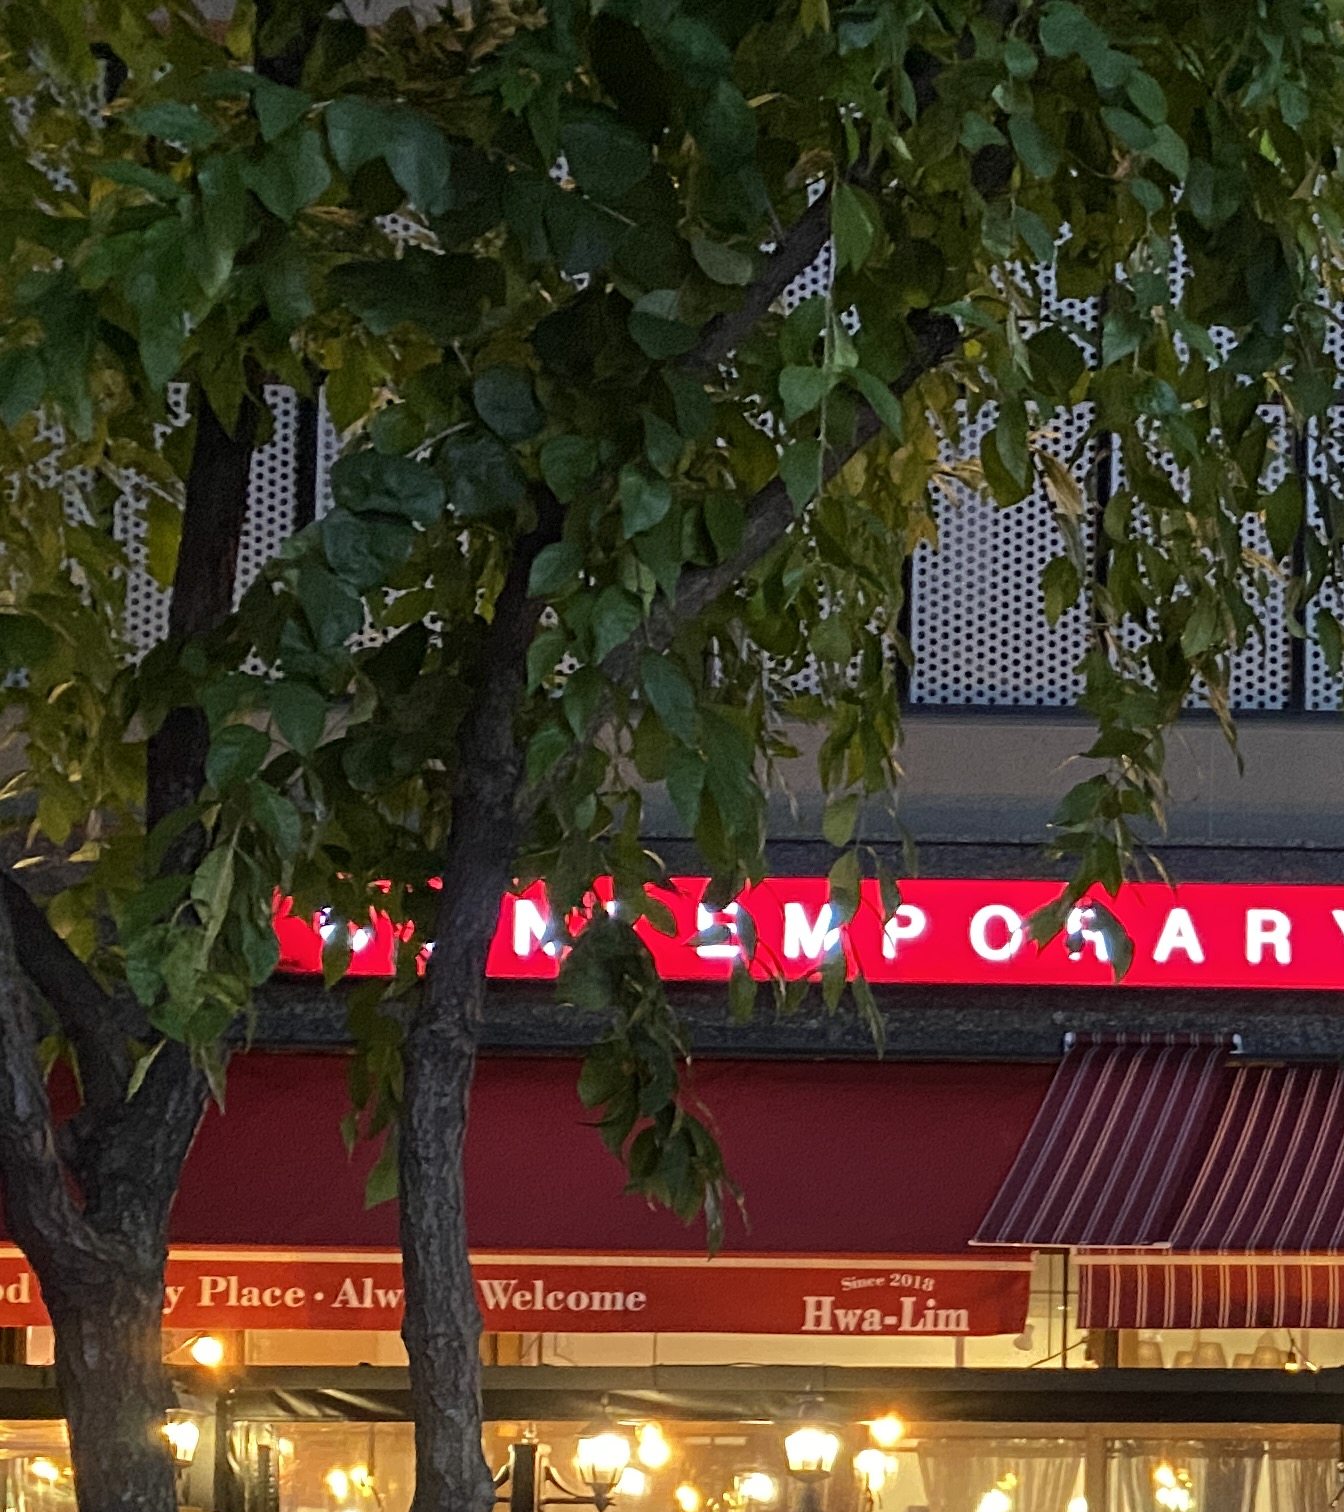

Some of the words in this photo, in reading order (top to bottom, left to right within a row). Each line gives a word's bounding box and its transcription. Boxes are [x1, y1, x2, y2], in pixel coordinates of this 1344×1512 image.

[197, 1275, 306, 1308] Place
[331, 1277, 404, 1309] Alw
[478, 1278, 648, 1313] Welcome
[841, 1276, 885, 1292] Since
[889, 1273, 935, 1292] 2018
[800, 1295, 970, 1333] Hwa-Lim
